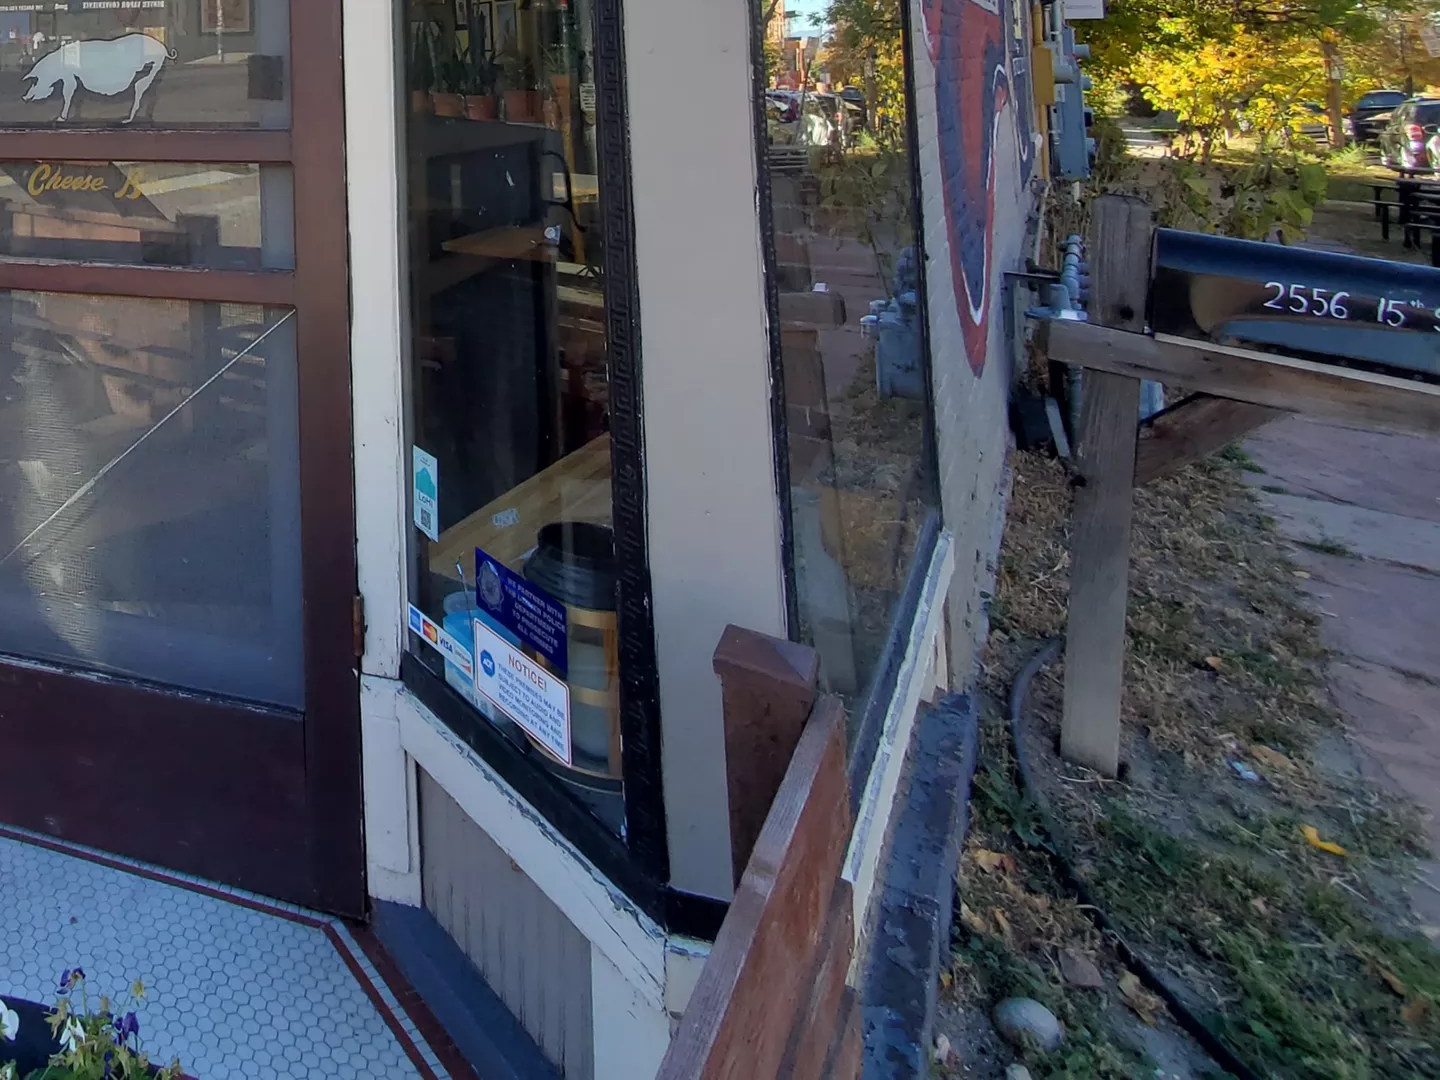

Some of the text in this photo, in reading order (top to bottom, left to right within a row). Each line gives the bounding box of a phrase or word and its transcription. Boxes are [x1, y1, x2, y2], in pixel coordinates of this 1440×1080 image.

[28, 163, 106, 196] Cheese
[1263, 281, 1350, 320] 2556
[439, 636, 454, 653] VISA
[508, 654, 547, 692] NOTICE!
